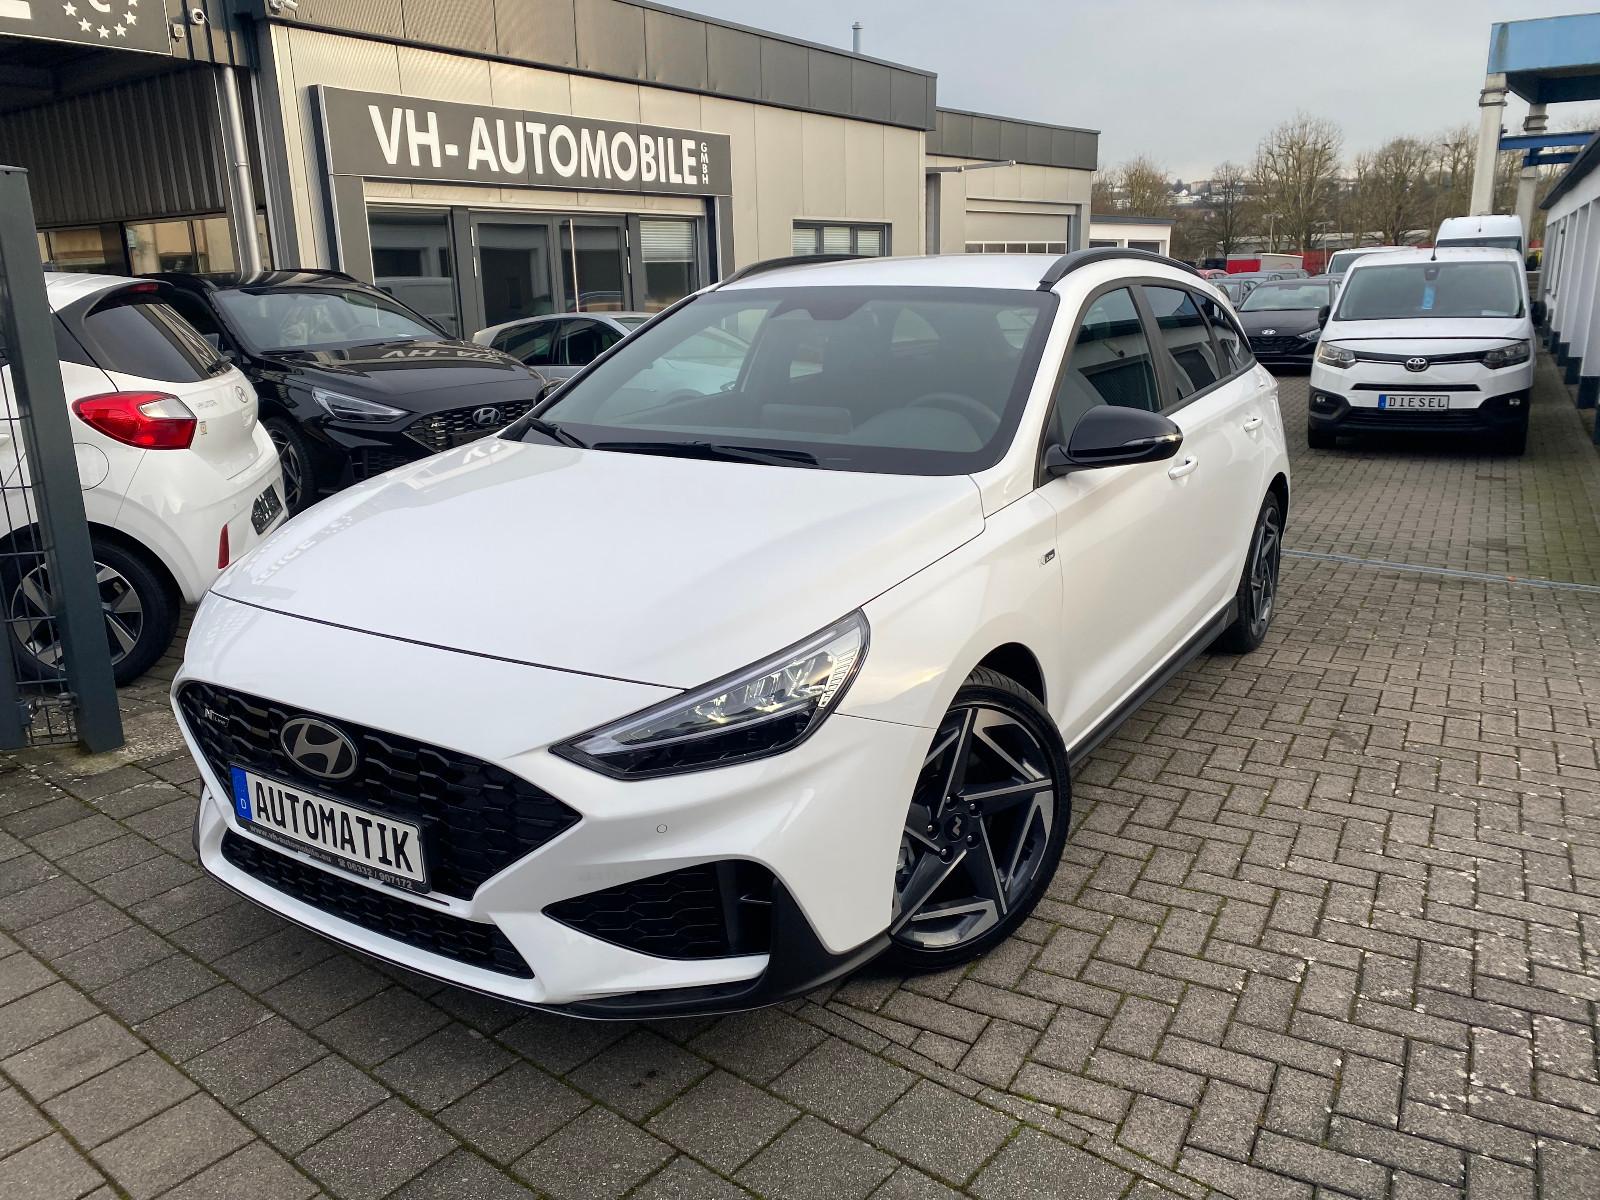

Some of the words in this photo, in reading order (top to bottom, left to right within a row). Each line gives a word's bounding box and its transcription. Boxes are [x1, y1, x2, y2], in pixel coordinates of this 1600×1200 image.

[368, 105, 459, 168] VH-
[468, 116, 698, 185] AUTOMOBILE
[700, 142, 709, 185] GMBH
[1388, 397, 1446, 408] DIESEL
[255, 781, 414, 873] AUTOMATIK
[378, 872, 413, 889] 907172
